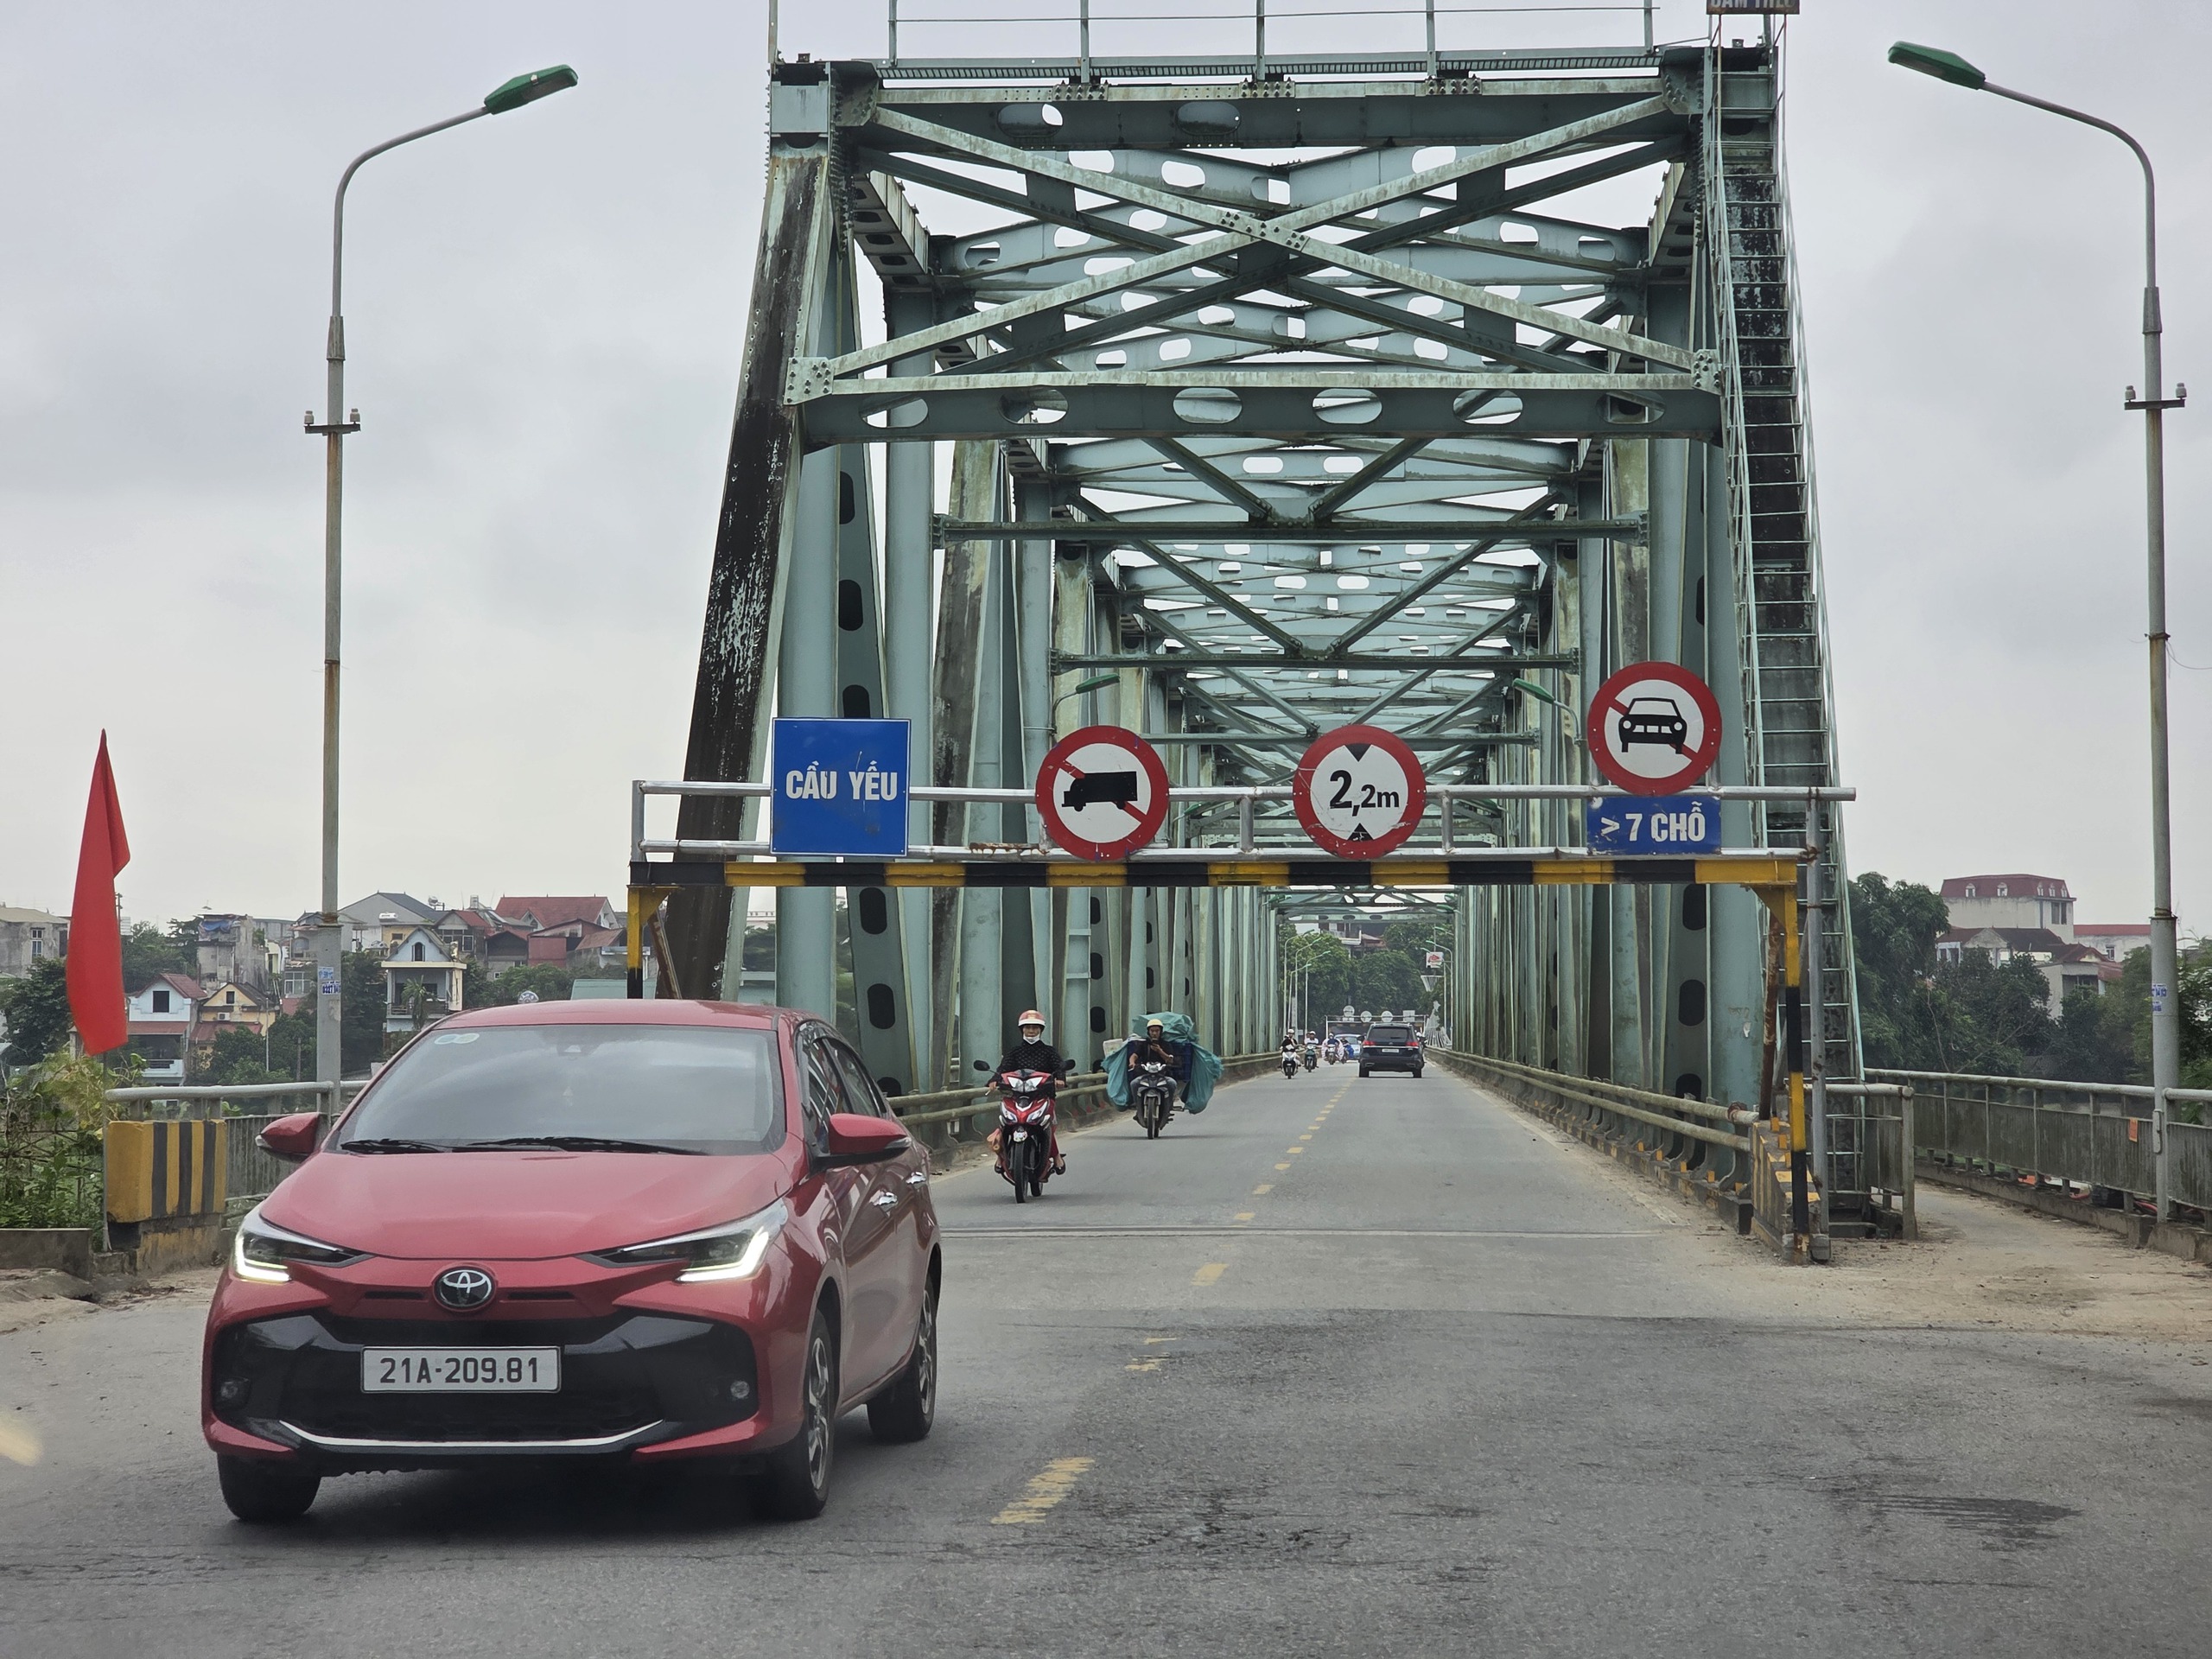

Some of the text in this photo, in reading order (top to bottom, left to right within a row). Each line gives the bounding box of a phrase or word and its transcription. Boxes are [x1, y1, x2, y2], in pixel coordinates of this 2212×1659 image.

[785, 760, 898, 801] CẦU YẾU
[1329, 769, 1400, 817] 2,2m
[1625, 813, 1643, 842] 7
[1650, 801, 1707, 842] CHỖ
[379, 1357, 538, 1383] 21A-209.81
